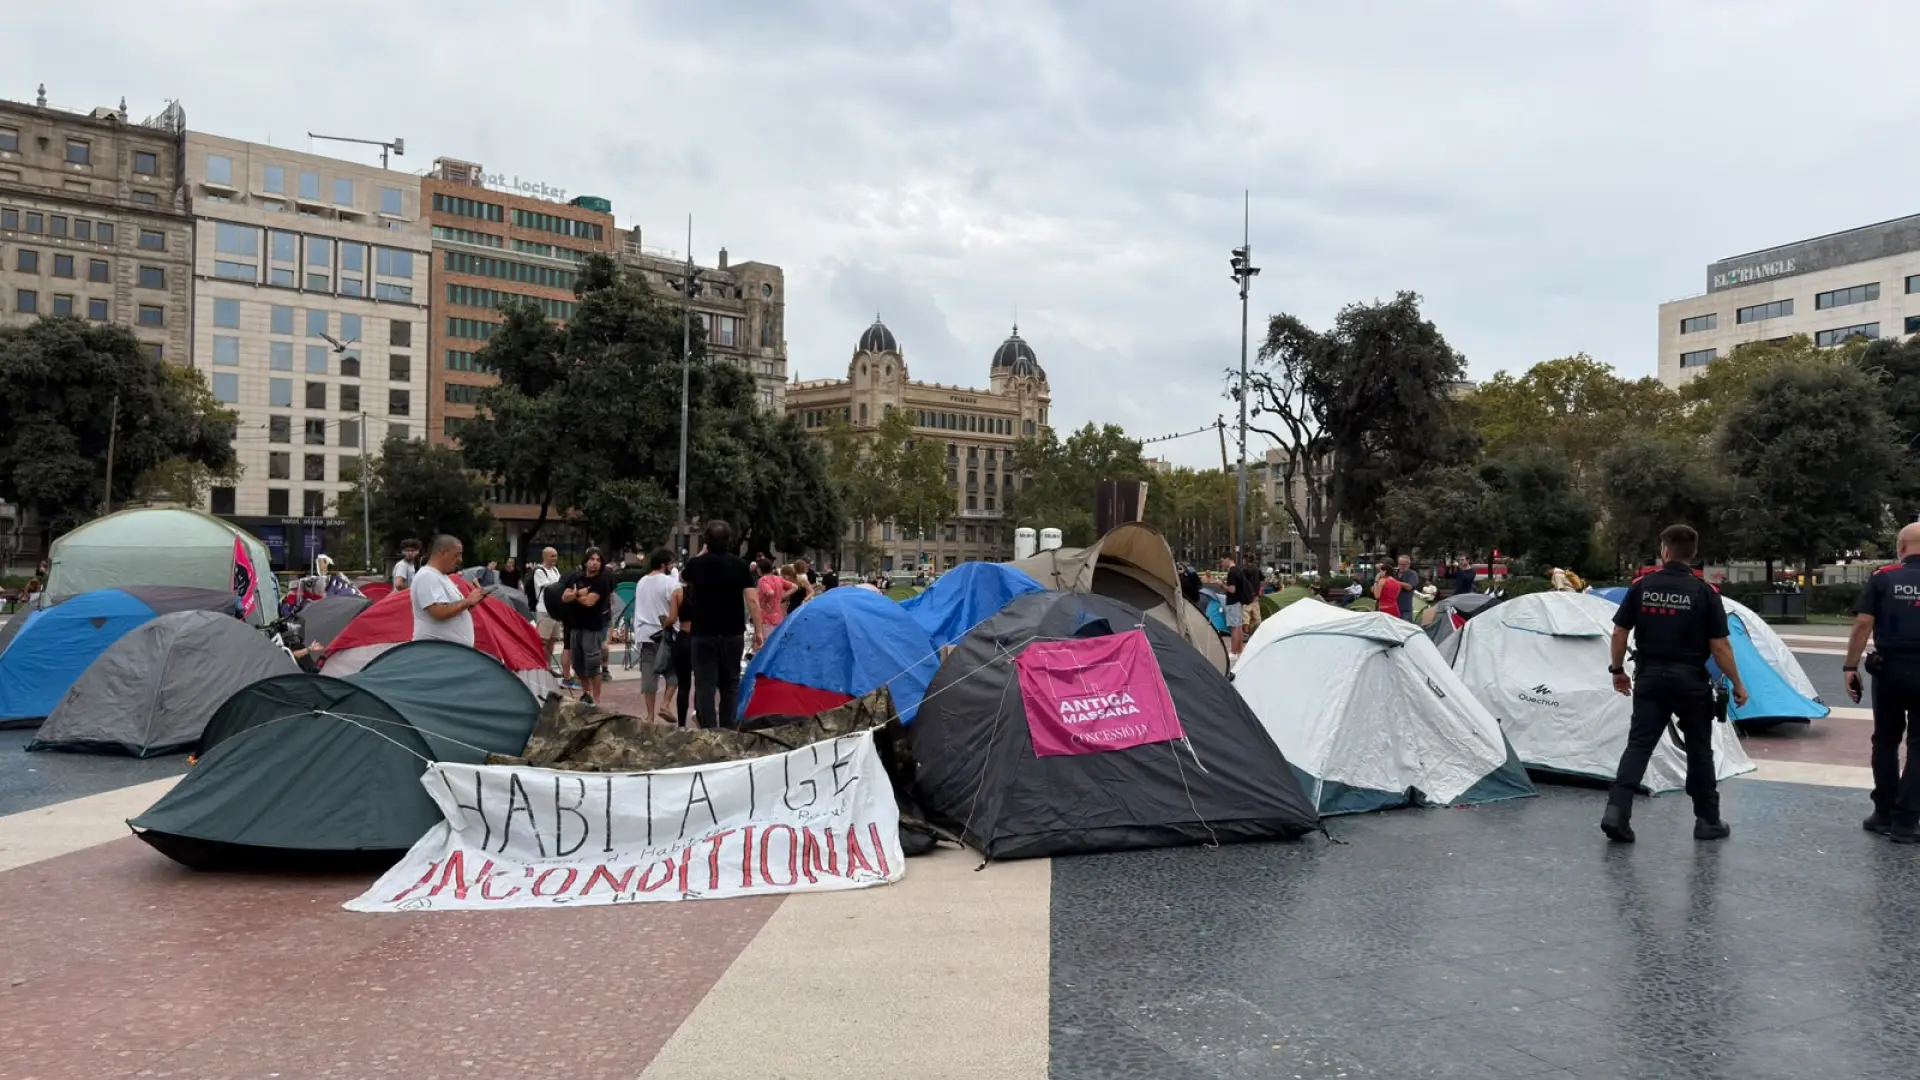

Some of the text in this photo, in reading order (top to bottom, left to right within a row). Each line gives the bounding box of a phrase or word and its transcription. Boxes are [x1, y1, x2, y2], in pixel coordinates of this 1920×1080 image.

[513, 175, 567, 199] Locker
[1728, 258, 1796, 284] TRIANGLE
[1642, 591, 1691, 605] POLICIA
[1060, 692, 1136, 714] ANTIGA
[1518, 693, 1560, 708] Quechua
[1062, 705, 1140, 724] MASSANA
[440, 734, 860, 857] HABITATGE
